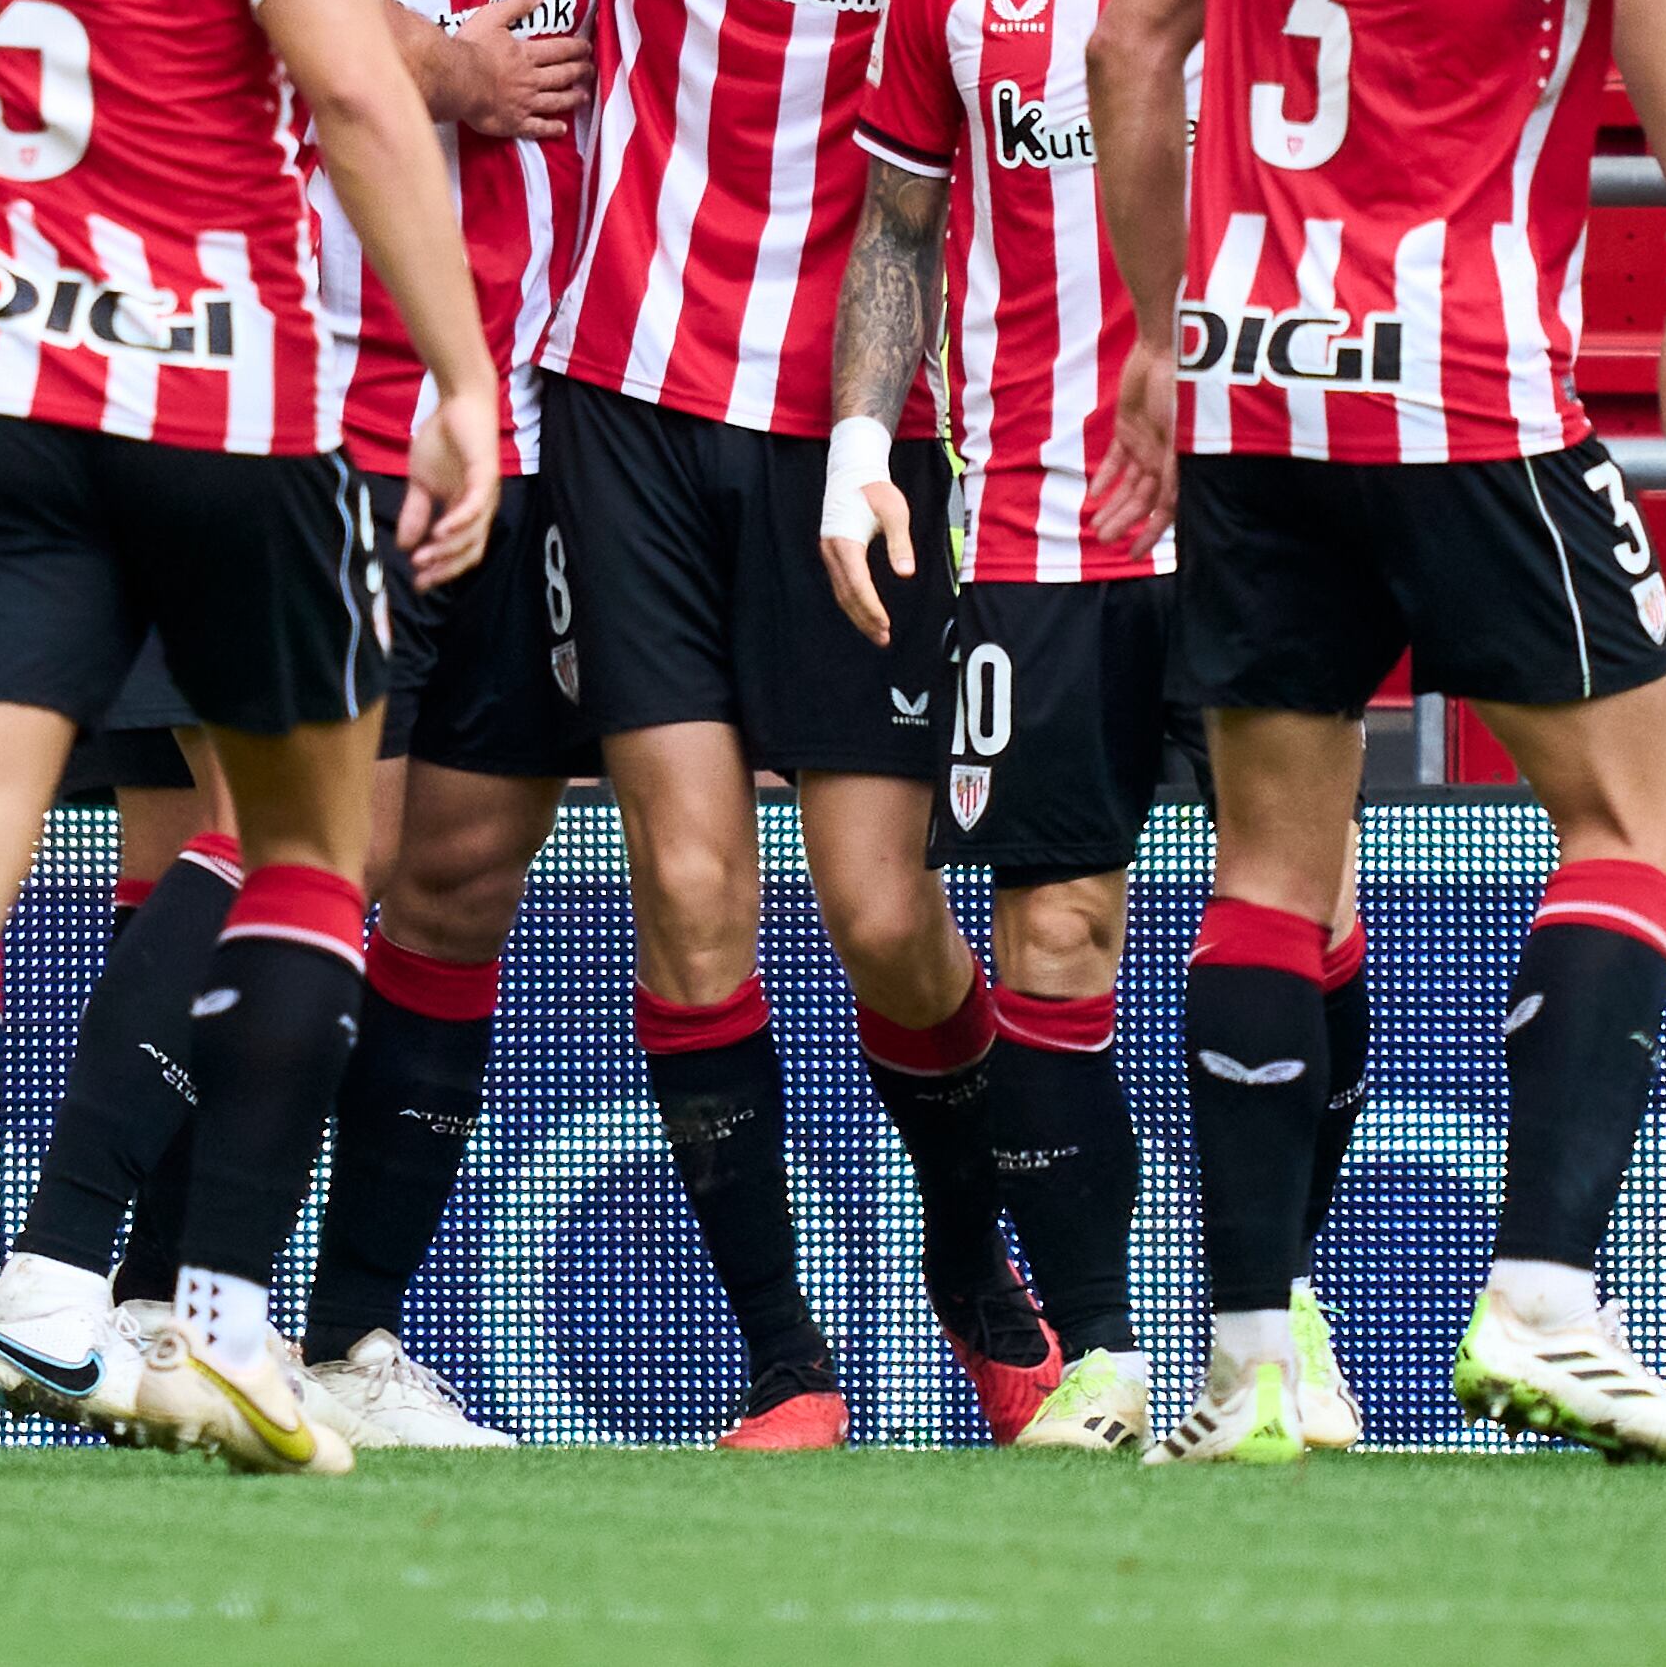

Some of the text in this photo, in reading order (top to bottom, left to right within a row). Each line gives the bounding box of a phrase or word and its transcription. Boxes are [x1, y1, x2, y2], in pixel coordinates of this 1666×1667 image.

[1177, 309, 1402, 382] DIGI
[1583, 459, 1653, 576] 3
[543, 523, 573, 636] 8
